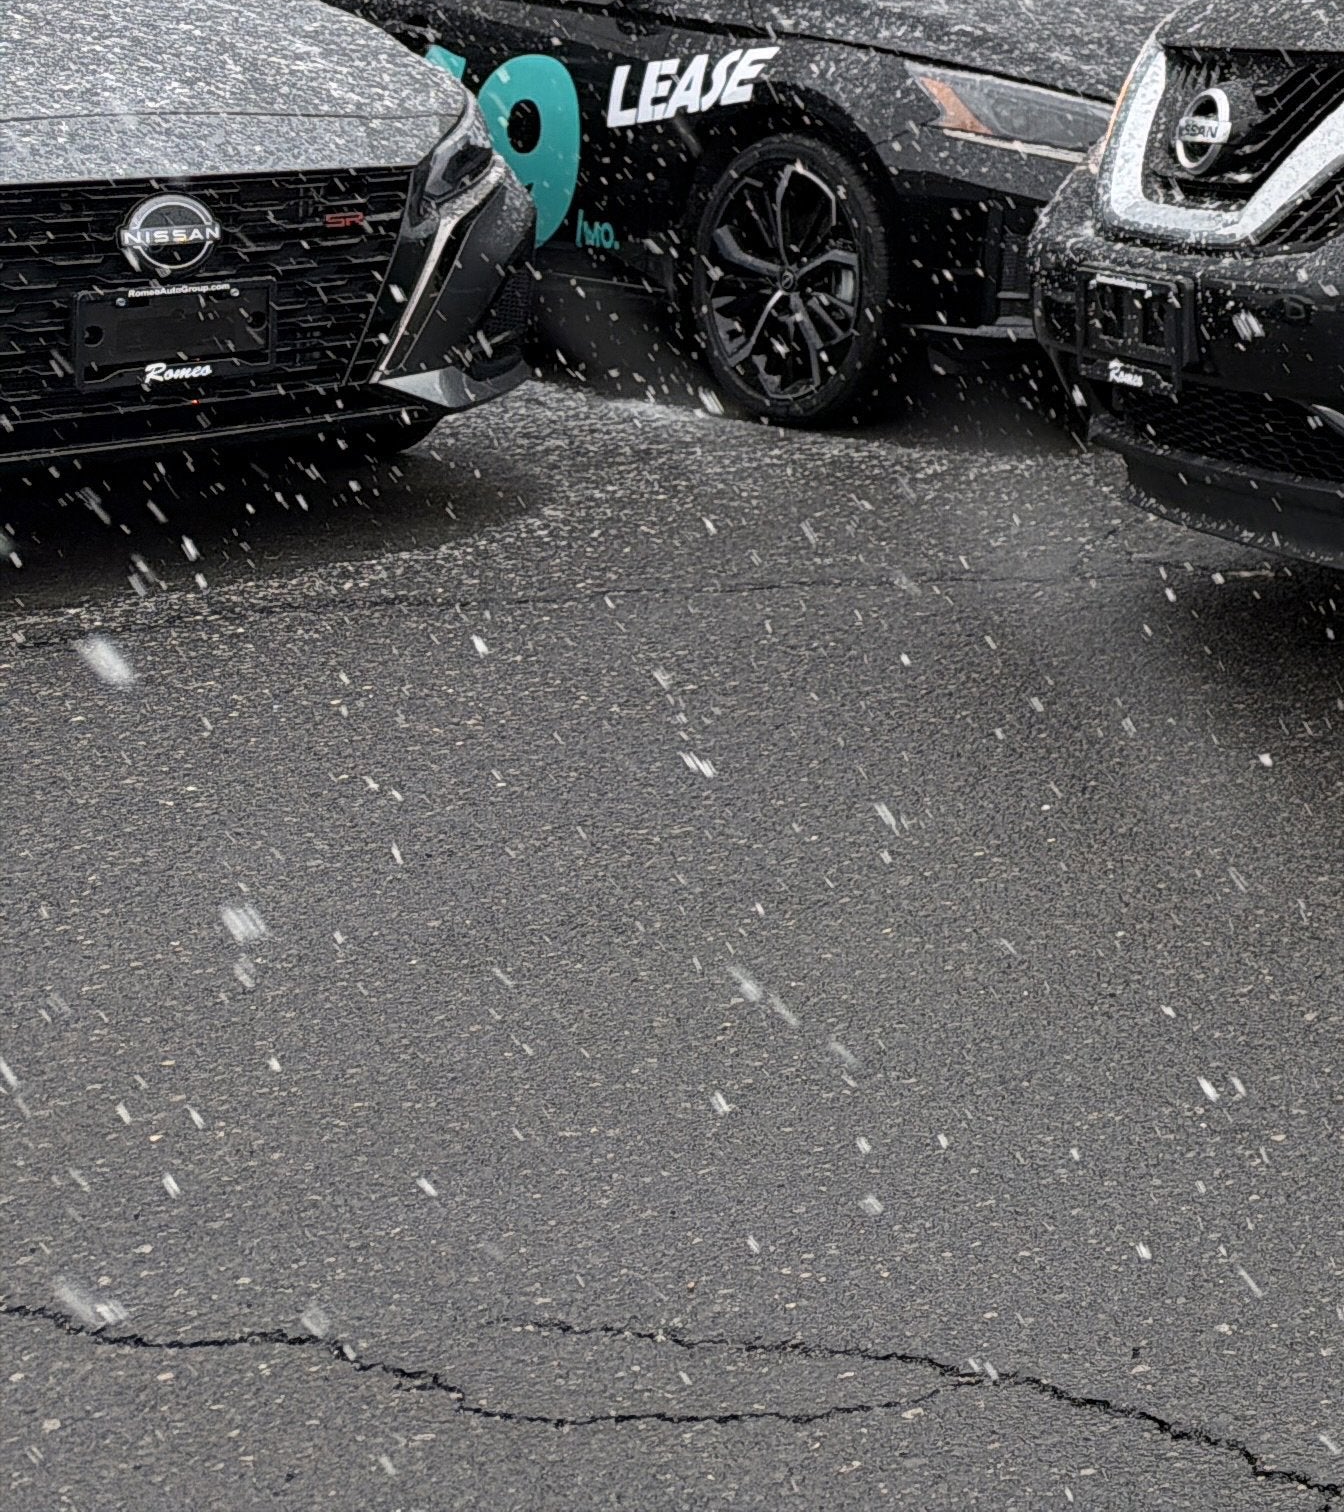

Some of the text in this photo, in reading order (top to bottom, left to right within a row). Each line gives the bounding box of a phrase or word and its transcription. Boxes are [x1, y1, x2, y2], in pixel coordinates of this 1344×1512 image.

[606, 45, 780, 128] LEASE
[326, 211, 364, 228] SR
[123, 224, 221, 246] NISSAN
[127, 283, 231, 298] RomeoAutoGroup.com
[144, 362, 213, 385] Romeo
